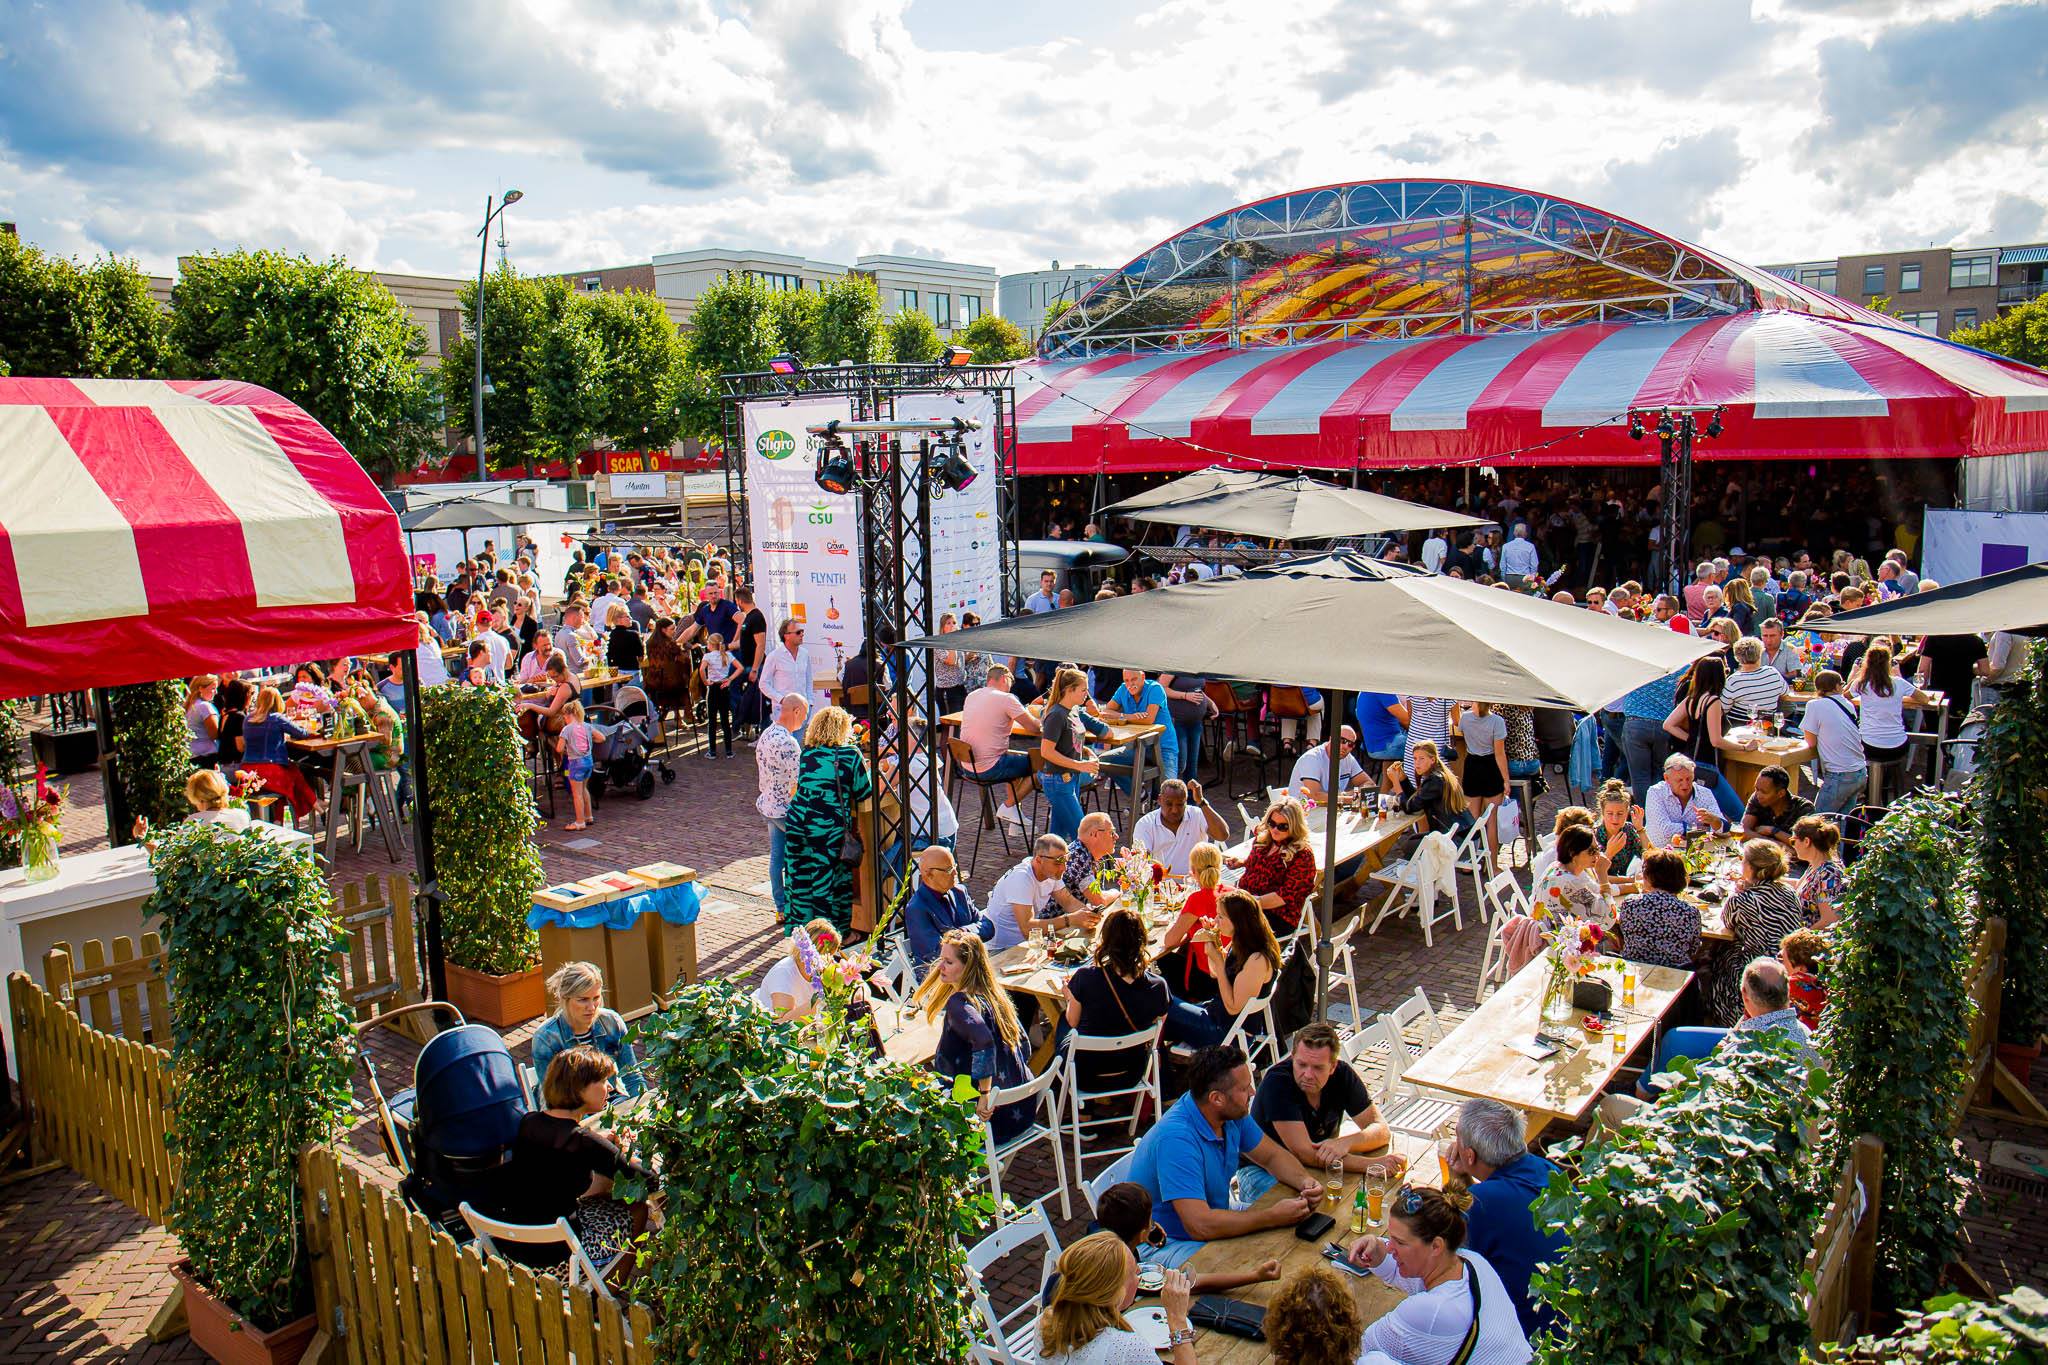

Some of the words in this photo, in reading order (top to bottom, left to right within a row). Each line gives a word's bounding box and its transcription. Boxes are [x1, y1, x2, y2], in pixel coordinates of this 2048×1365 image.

[758, 437, 795, 453] Sligro
[610, 457, 659, 473] SCAPIO
[808, 512, 833, 525] CSU
[826, 542, 845, 550] Crown
[810, 572, 847, 584] FLYNTH
